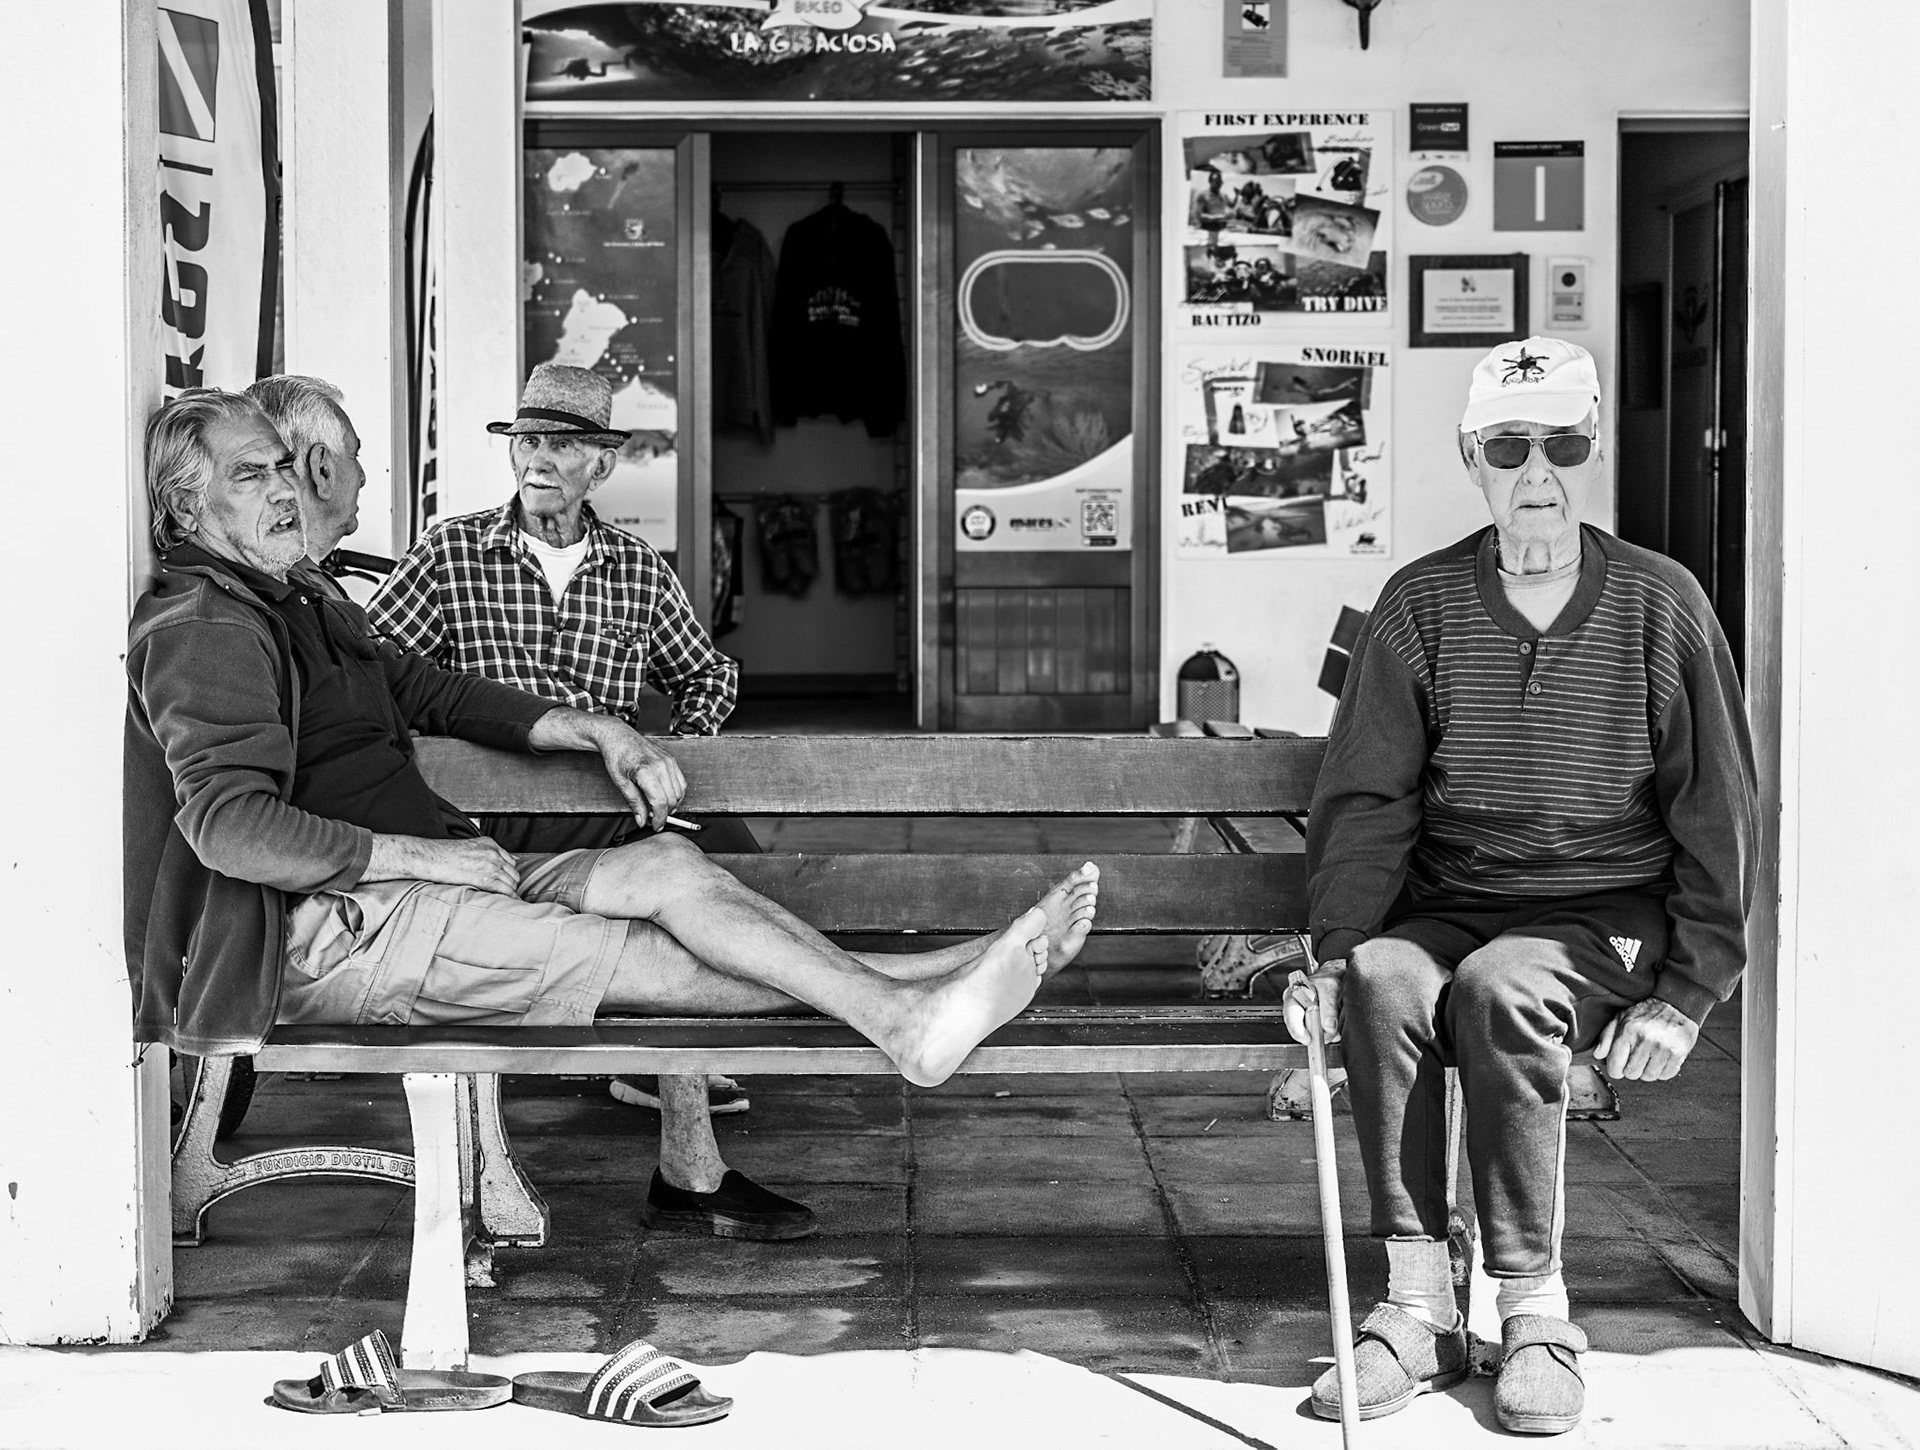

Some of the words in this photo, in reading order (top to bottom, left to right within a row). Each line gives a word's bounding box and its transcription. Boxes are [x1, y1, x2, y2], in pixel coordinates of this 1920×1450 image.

[794, 0, 842, 14] BUCEO
[730, 31, 760, 53] LA
[1205, 113, 1257, 126] FIRST
[1264, 113, 1370, 126] EXPERENCE
[1302, 296, 1339, 312] TRY
[1343, 296, 1387, 312] DIVE
[1192, 314, 1261, 327] BAUTIZO
[1301, 347, 1390, 367] SNORKEL
[1010, 517, 1053, 529] mares
[254, 1153, 326, 1173] FUNDICIO
[331, 1153, 384, 1170] DUCTIL
